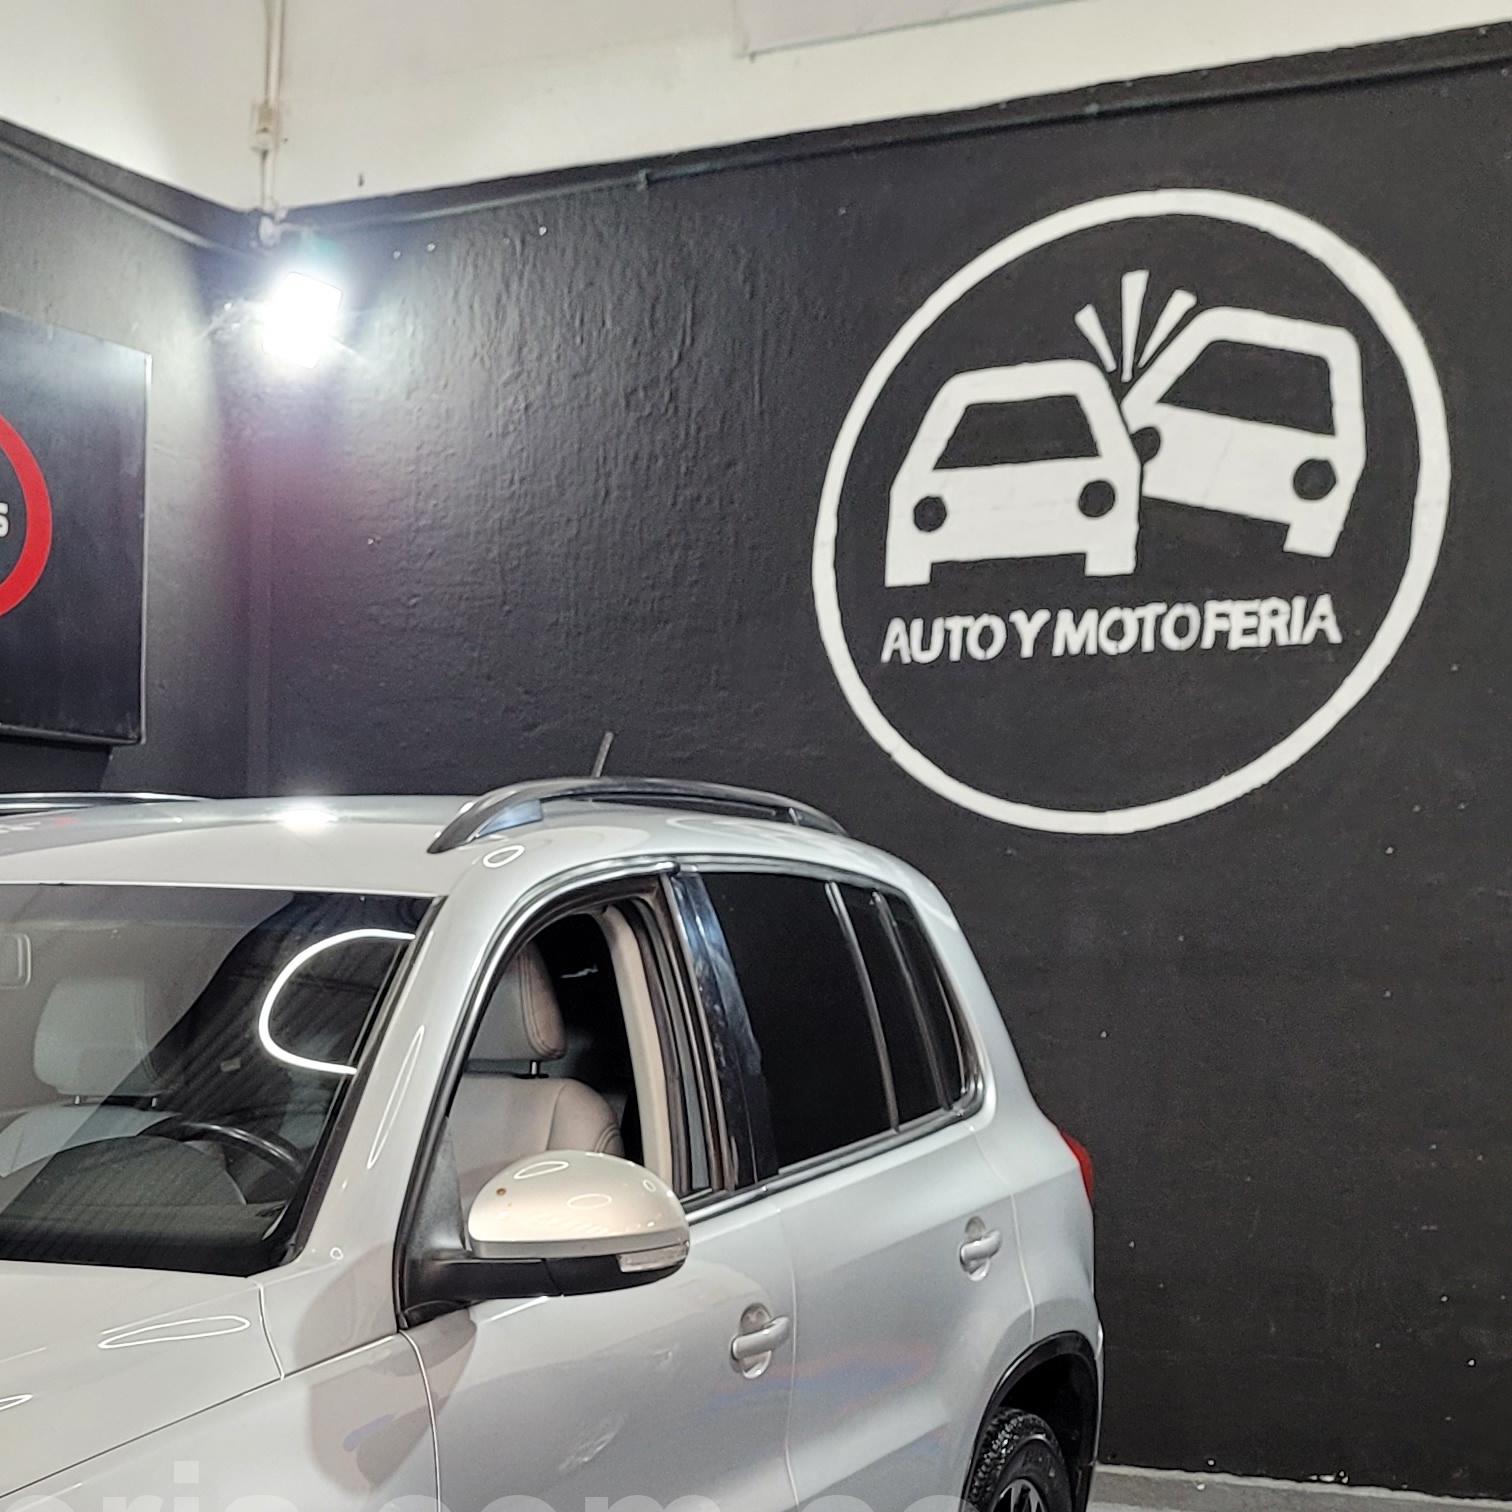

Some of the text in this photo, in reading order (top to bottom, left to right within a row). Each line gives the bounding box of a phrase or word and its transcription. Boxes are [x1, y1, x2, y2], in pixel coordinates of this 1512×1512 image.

[881, 594, 1343, 663] AUTO Y MOTOFERIA
